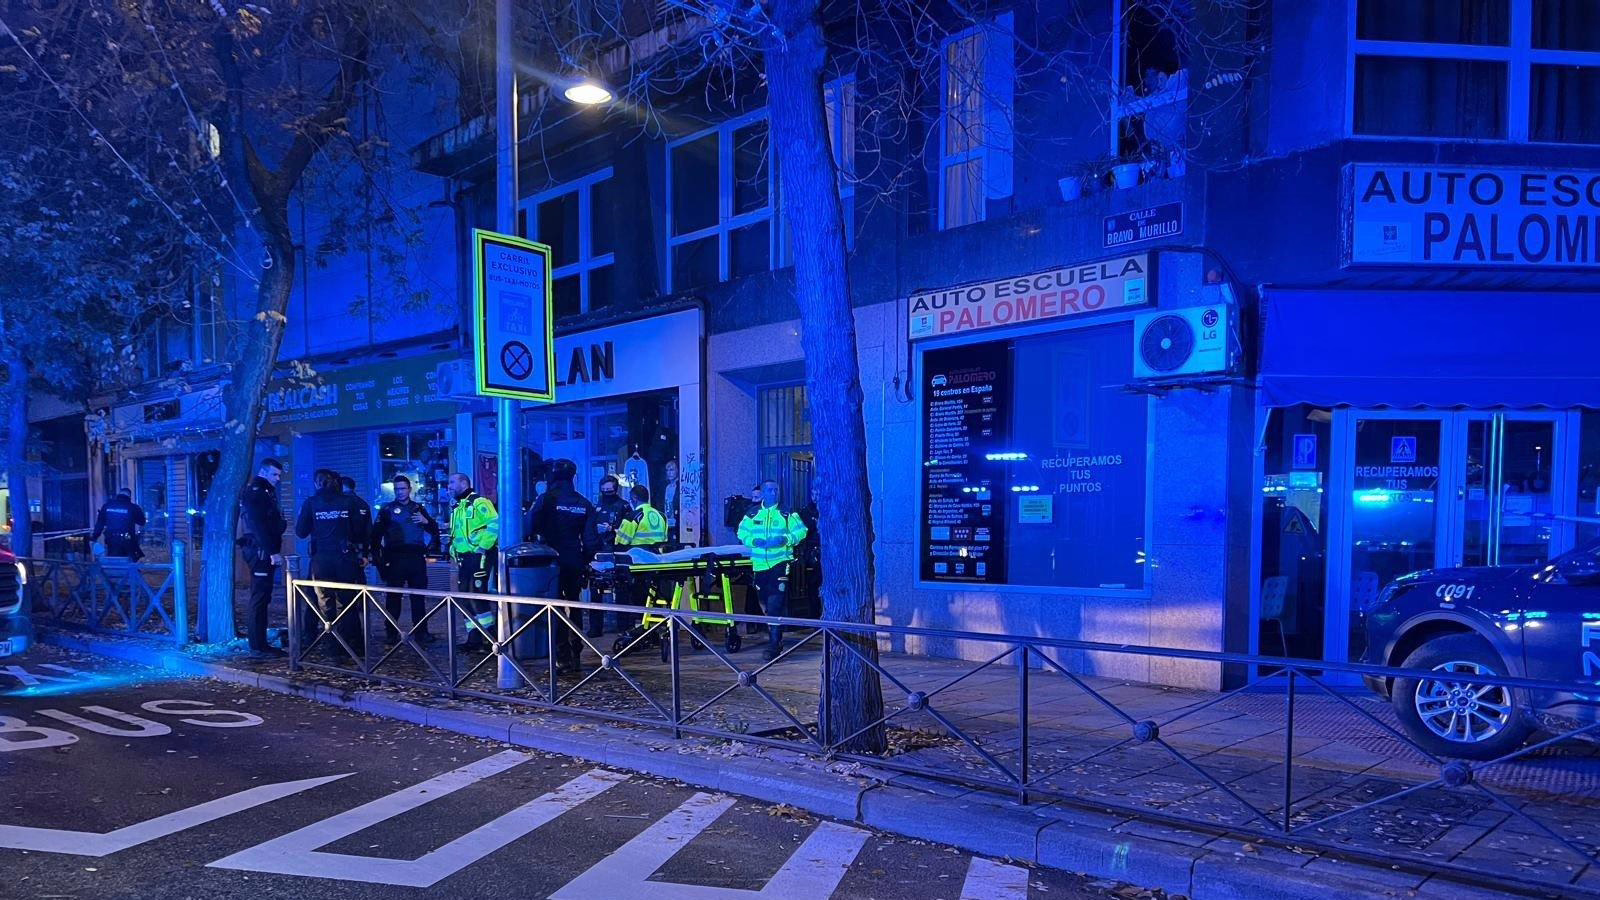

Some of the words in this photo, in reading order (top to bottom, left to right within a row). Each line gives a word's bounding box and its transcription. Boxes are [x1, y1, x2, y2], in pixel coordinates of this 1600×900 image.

[1360, 170, 1504, 206] AUTO
[1129, 208, 1156, 221] CALLE
[1107, 229, 1134, 245] BRAVO
[1139, 219, 1178, 239] MURILLO
[1423, 212, 1600, 264] PALOM
[500, 252, 530, 265] CARRIL
[491, 261, 538, 277] EXCLUSIVO
[911, 287, 987, 314] AUTO
[993, 258, 1144, 299] ESCUELA
[938, 284, 1107, 333] PALOMERO
[1203, 330, 1217, 340] LG
[1041, 455, 1122, 469] RECUPERAMOS
[1070, 469, 1091, 480] TUS
[1355, 466, 1439, 477] RECUPERAMOS
[1059, 482, 1102, 494] PUNTOS
[1386, 479, 1408, 490] TUS
[0, 700, 264, 752] BUS
